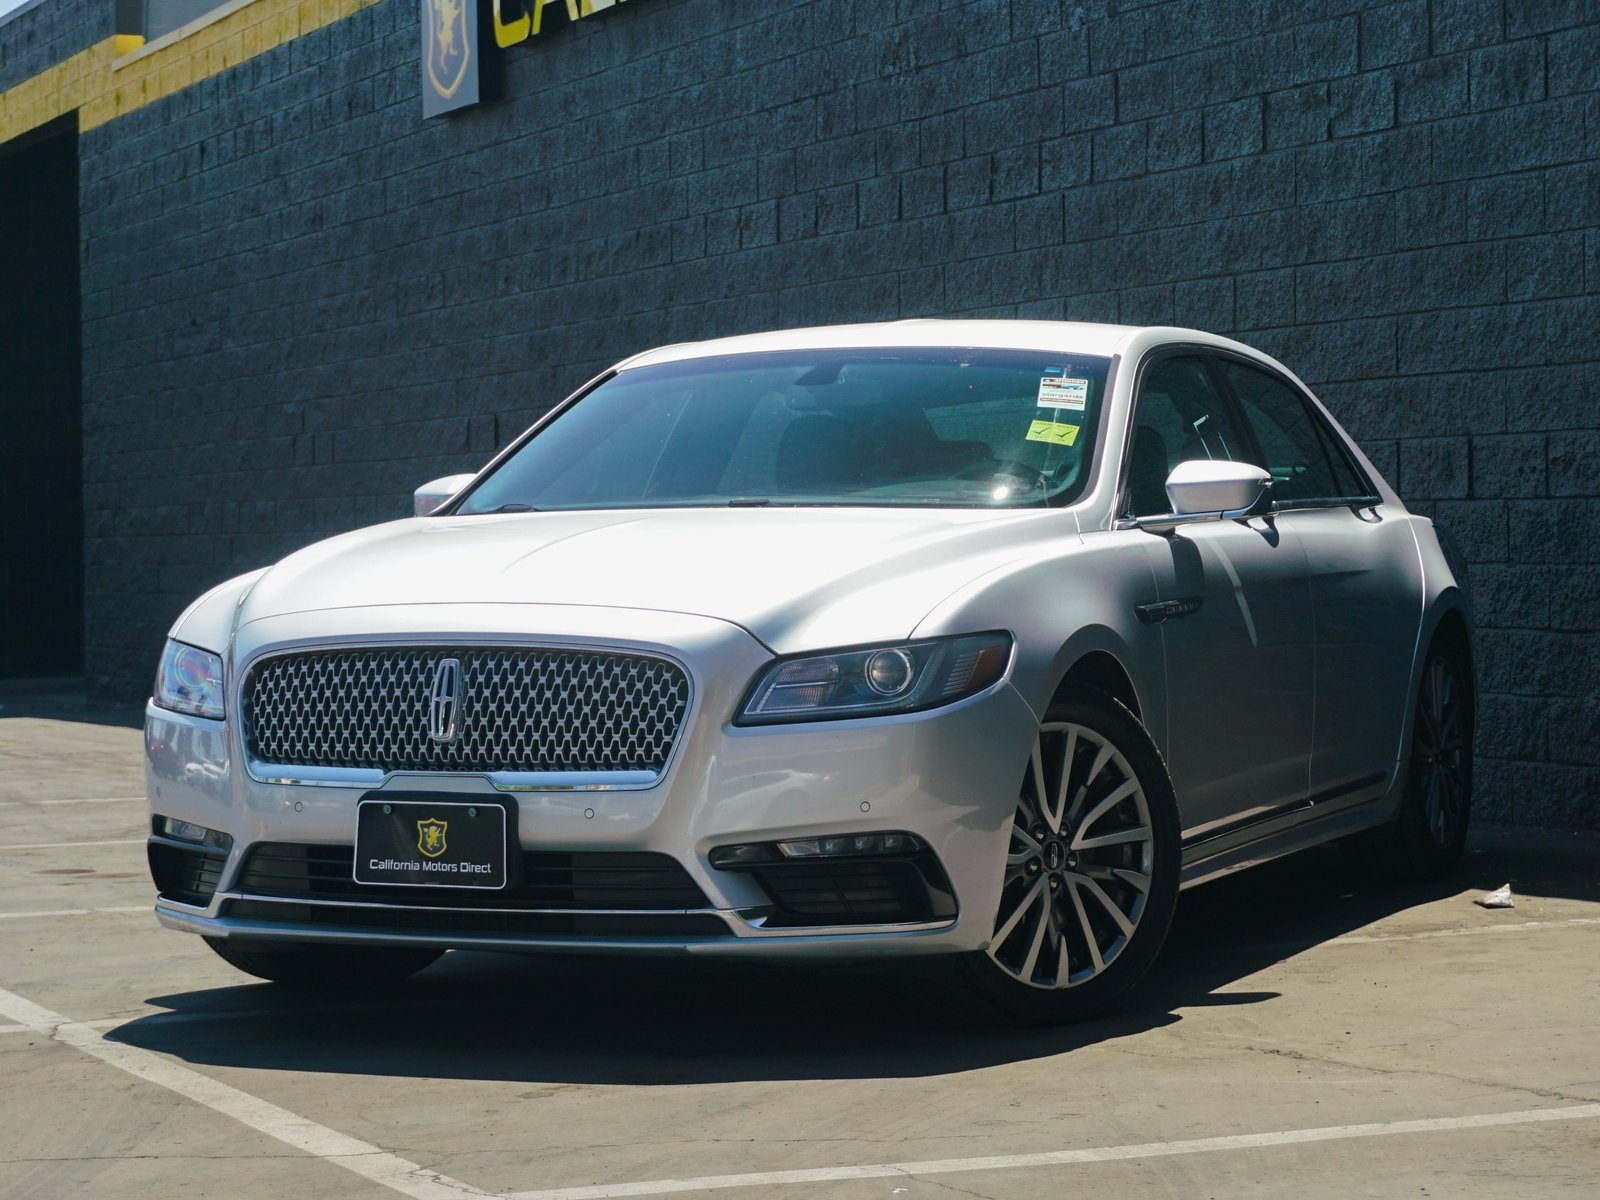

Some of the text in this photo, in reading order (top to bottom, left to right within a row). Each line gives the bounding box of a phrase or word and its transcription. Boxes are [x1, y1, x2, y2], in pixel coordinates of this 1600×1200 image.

[369, 859, 491, 873] California Motors Direct
